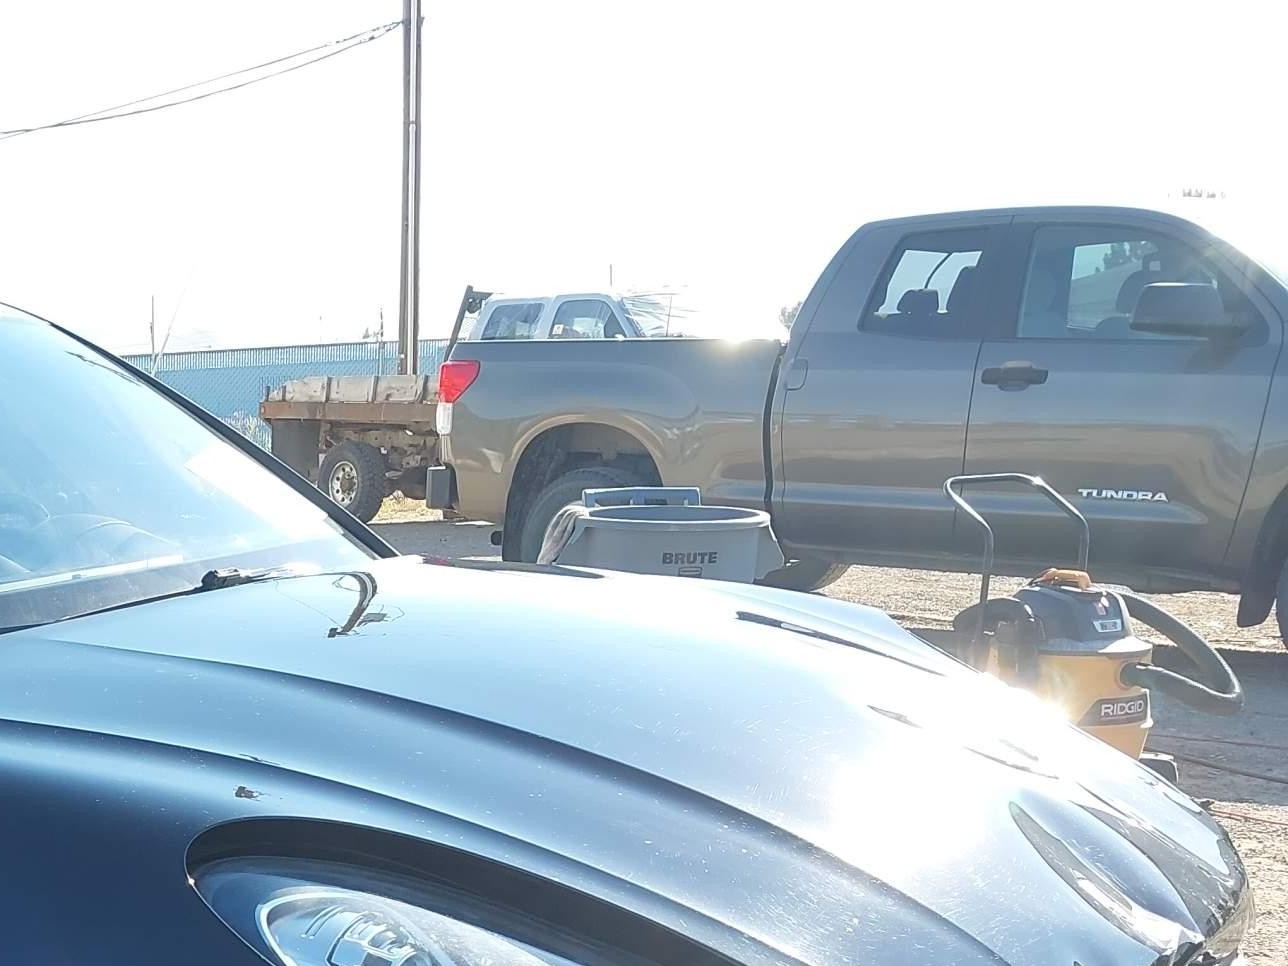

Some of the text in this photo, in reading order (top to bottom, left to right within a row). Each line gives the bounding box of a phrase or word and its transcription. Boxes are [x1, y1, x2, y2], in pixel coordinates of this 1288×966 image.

[1078, 488, 1169, 503] TUNDRA
[662, 551, 718, 565] BRUTE
[1101, 701, 1145, 716] RIDGID
